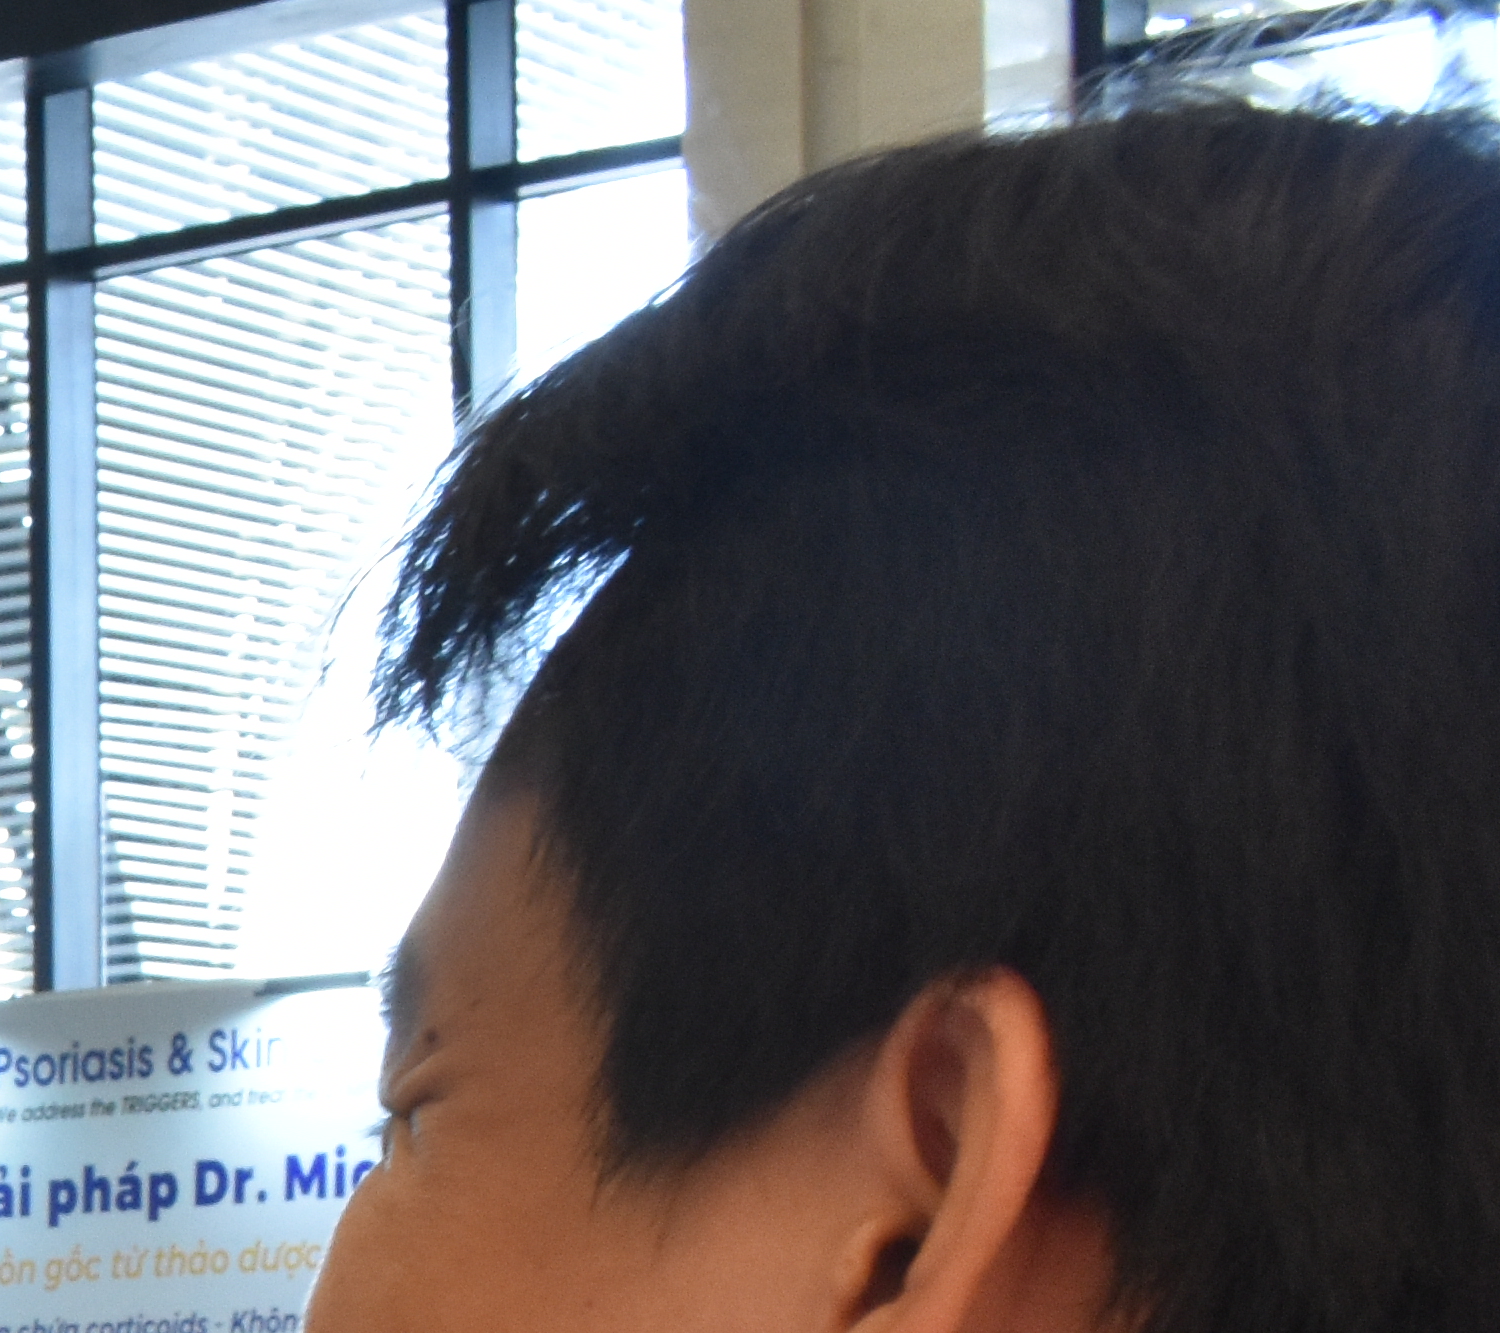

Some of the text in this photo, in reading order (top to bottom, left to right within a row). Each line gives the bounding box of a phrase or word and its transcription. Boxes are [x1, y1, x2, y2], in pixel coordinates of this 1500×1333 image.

[168, 1031, 193, 1076] &
[208, 1088, 243, 1109] and
[47, 1160, 178, 1228] pháp
[194, 1158, 268, 1207] Dr.
[44, 1244, 101, 1292] gốc
[110, 1244, 148, 1279] từ
[154, 1240, 231, 1277] thảo
